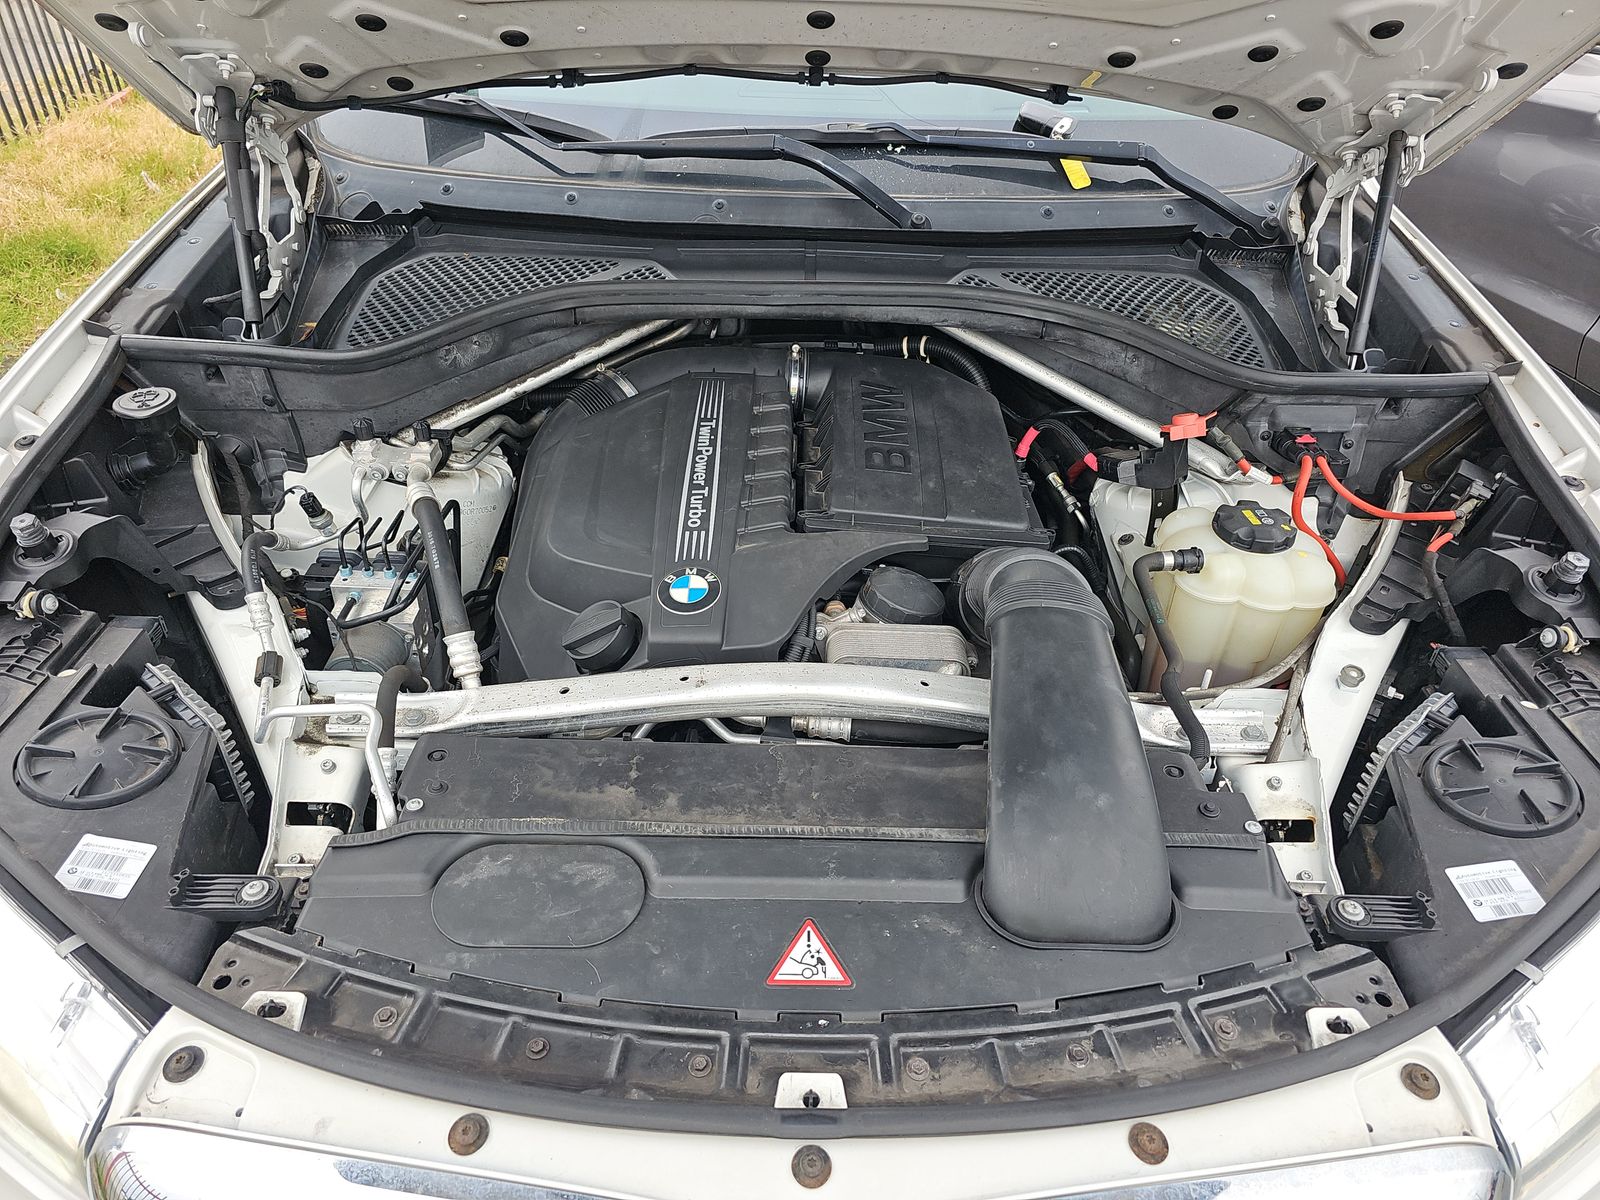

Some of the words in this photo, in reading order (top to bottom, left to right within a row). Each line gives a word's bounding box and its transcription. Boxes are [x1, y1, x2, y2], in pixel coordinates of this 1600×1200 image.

[692, 419, 716, 486] TwinPower
[861, 381, 912, 475] BMW
[687, 486, 709, 528] Turbo
[664, 567, 718, 584] BMW
